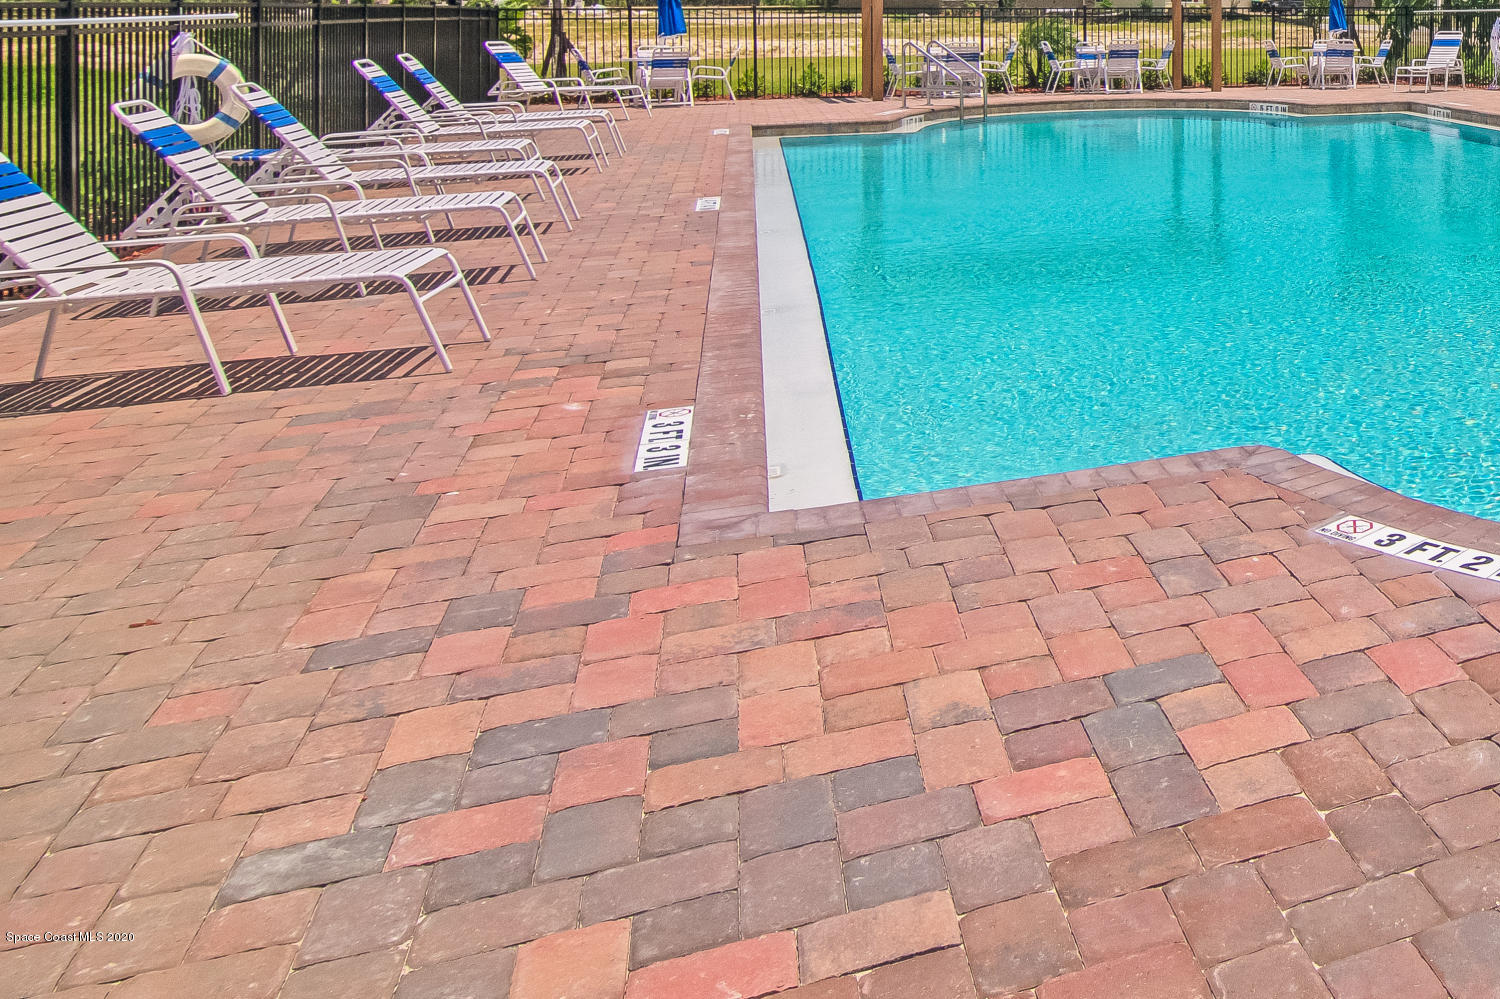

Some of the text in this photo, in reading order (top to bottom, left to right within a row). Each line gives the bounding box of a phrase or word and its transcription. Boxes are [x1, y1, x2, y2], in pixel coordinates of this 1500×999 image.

[651, 420, 685, 429] 3
[646, 444, 682, 453] 3
[1373, 533, 1407, 547] 3
[1403, 541, 1460, 563] FT.
[1459, 555, 1494, 572] 2
